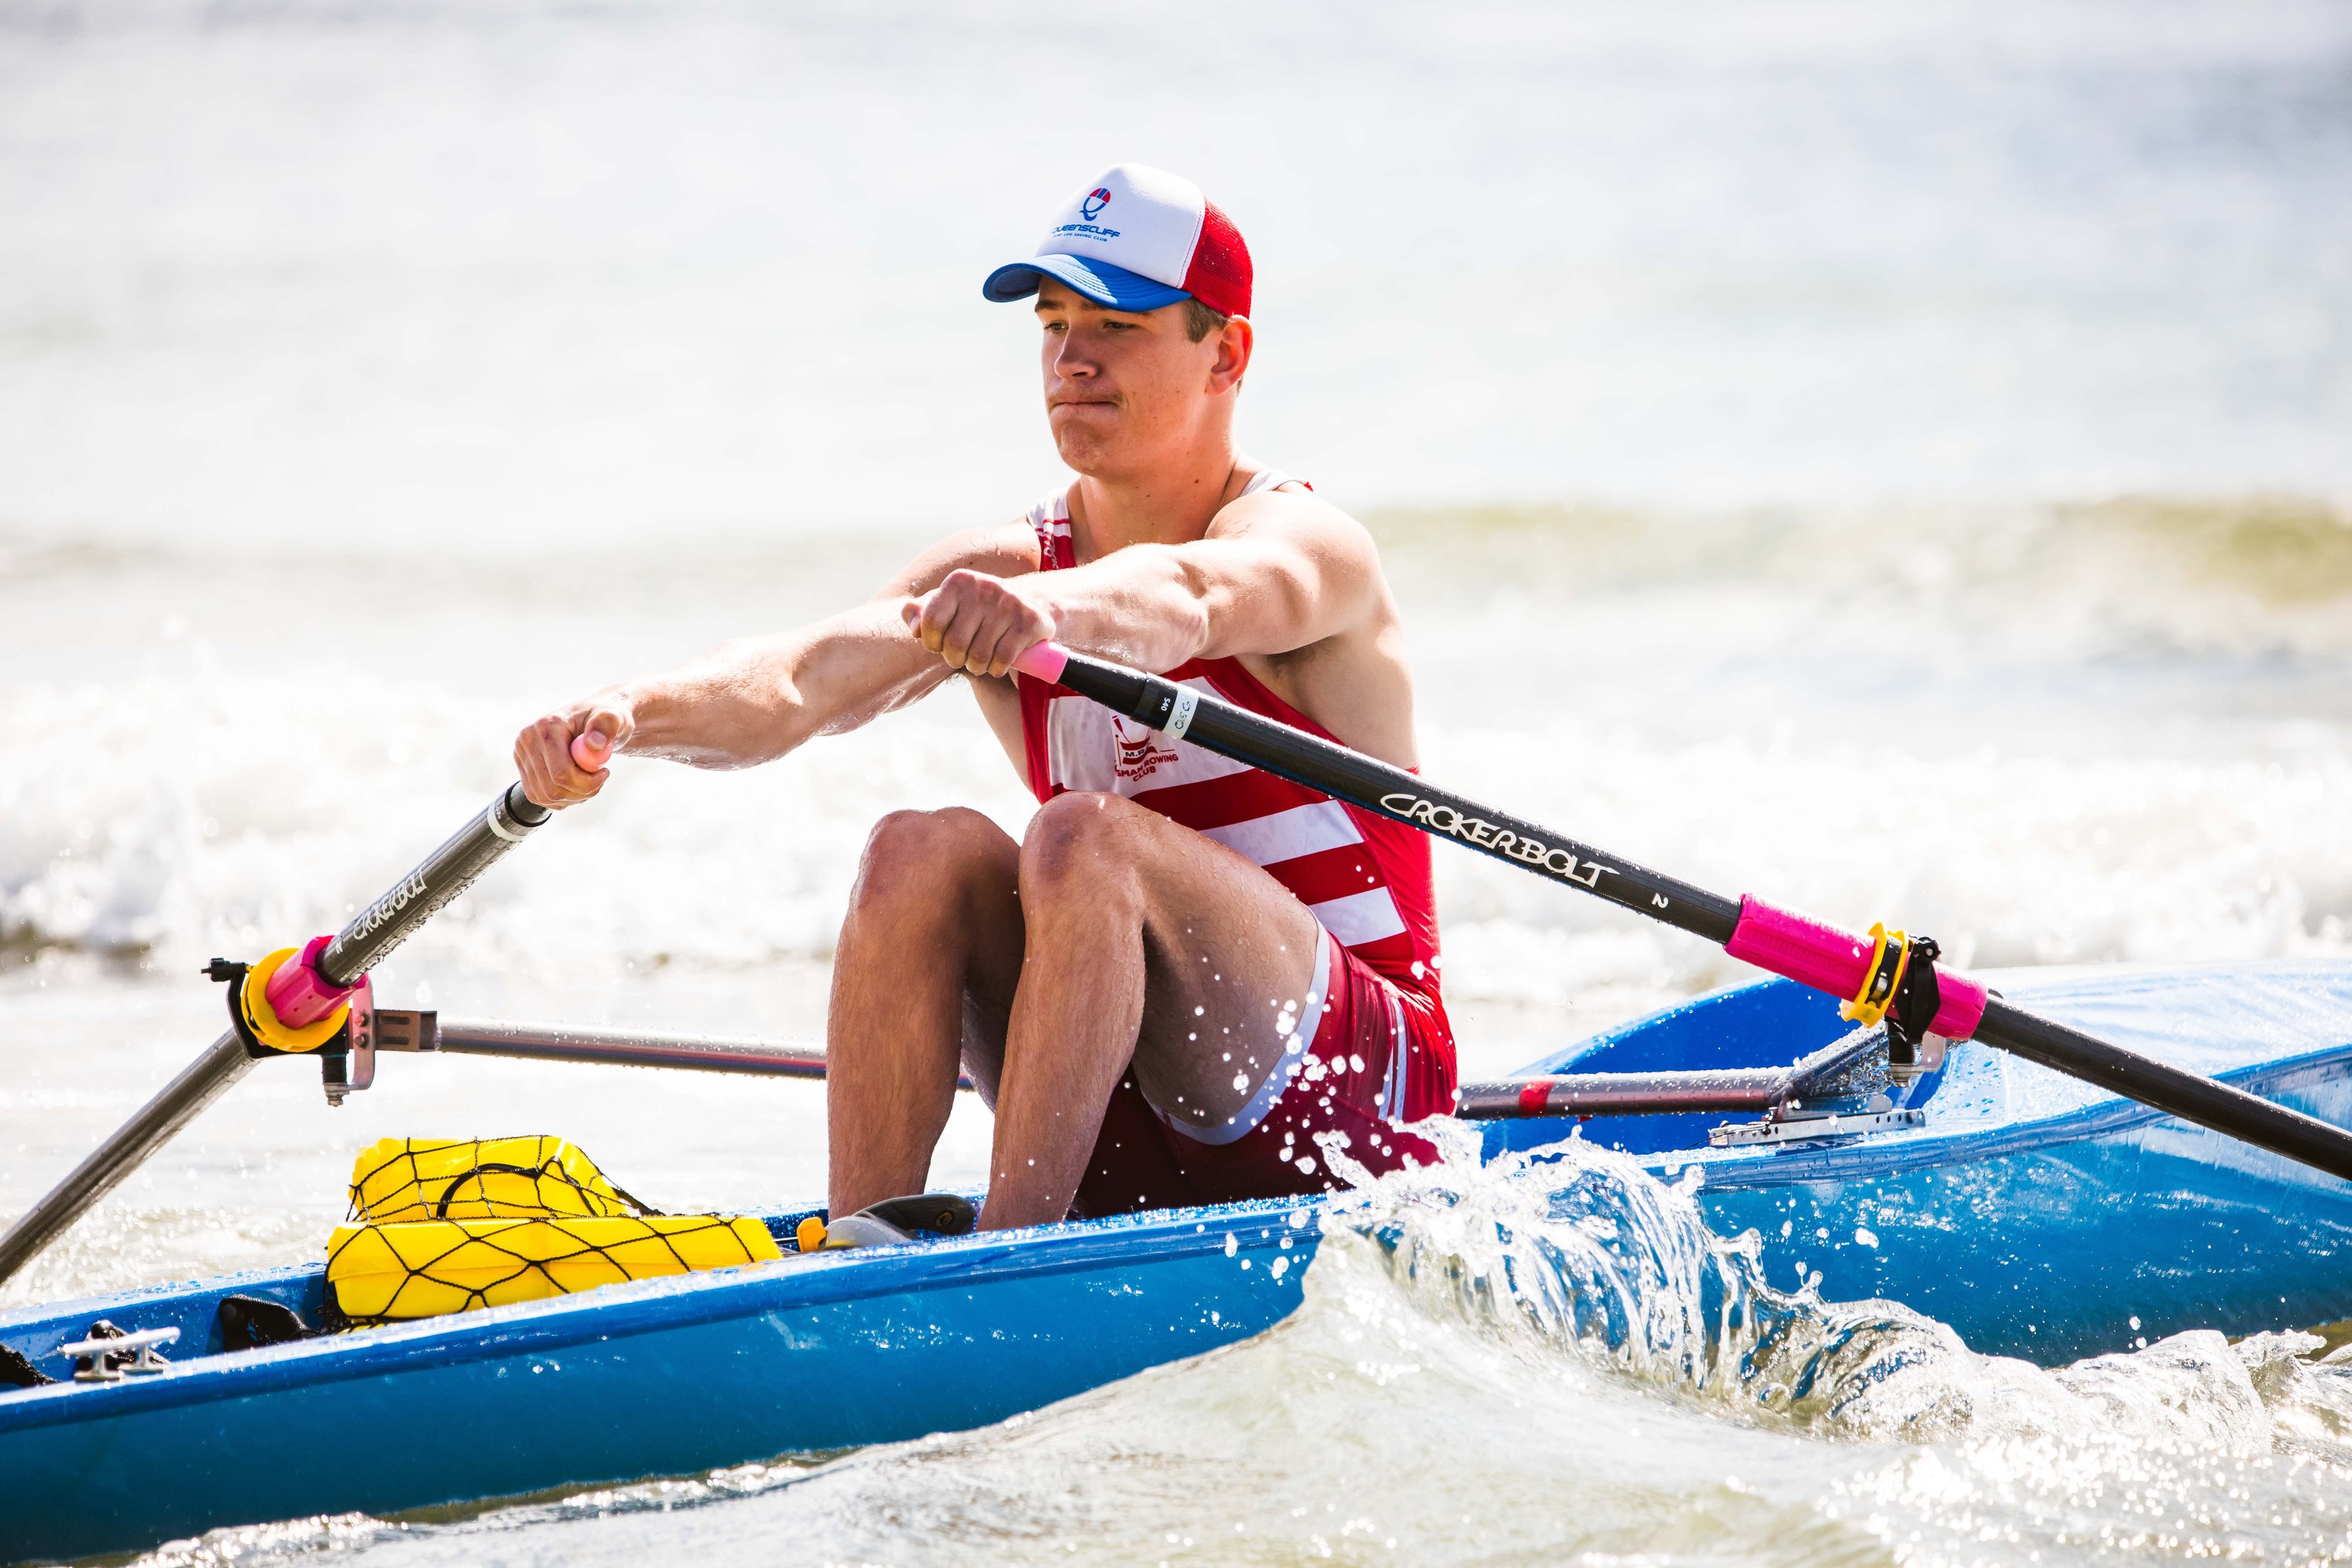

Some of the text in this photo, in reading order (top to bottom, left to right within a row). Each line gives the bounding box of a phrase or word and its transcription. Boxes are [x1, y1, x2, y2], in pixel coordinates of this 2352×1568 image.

[1160, 697, 1171, 712] S40
[1114, 753, 1179, 777] SMAN ROWING
[1133, 765, 1156, 782] CLUB
[1380, 793, 1621, 887] CROKERBOLT
